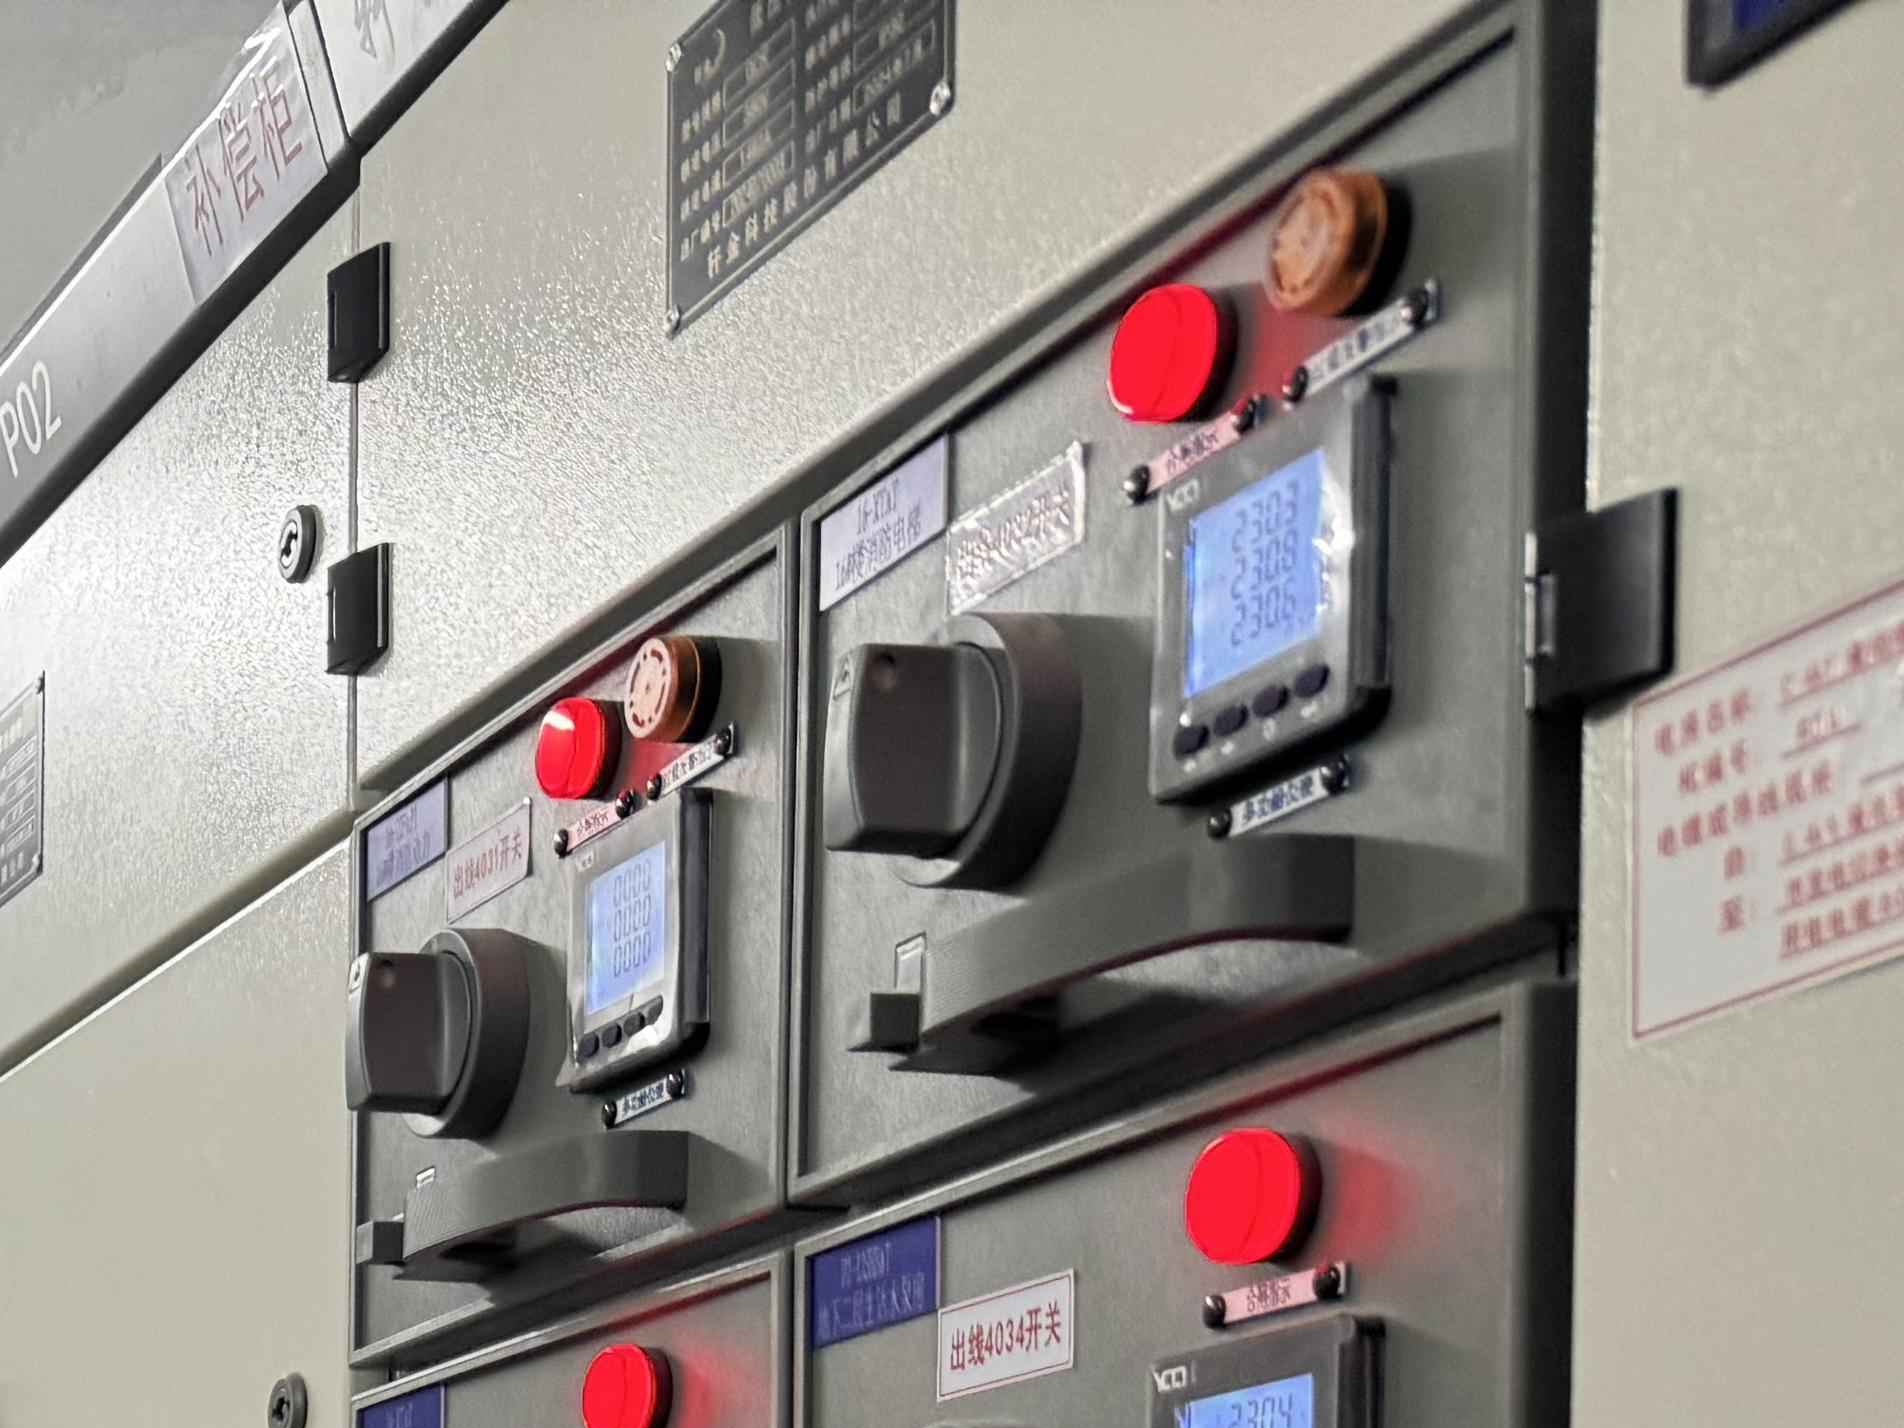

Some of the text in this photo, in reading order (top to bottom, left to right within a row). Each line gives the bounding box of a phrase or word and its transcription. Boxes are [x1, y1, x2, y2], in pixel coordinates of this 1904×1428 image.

[186, 56, 304, 257] 补偿柜
[950, 1301, 1062, 1371] 出线4034开关
